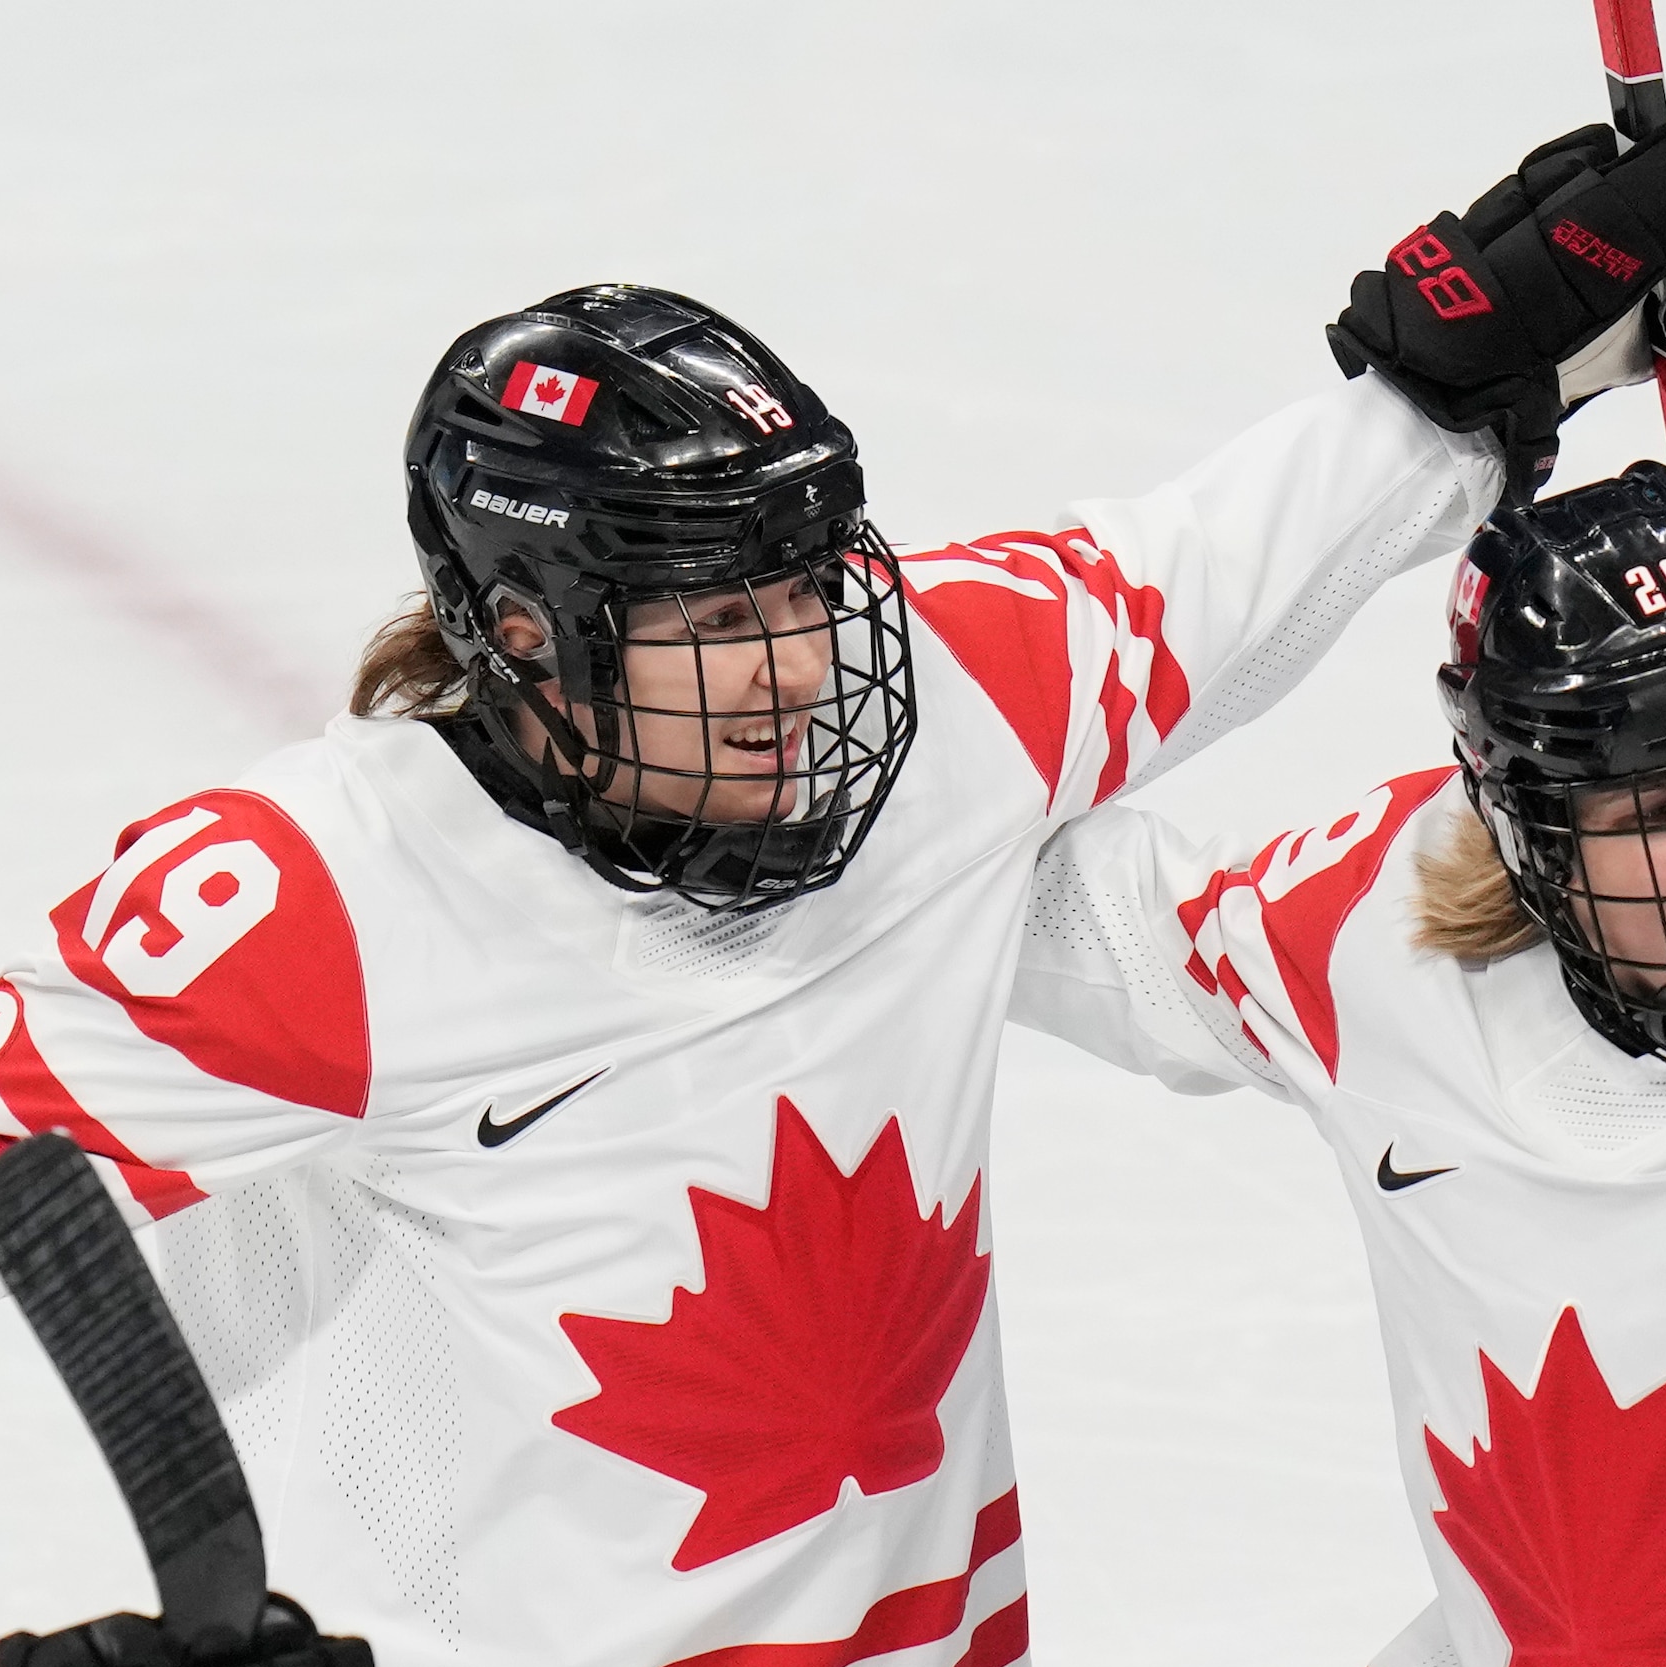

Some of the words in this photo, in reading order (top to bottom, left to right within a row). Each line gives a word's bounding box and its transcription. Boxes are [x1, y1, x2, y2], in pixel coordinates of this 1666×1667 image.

[1386, 224, 1493, 320] BA
[725, 383, 796, 435] 19
[81, 805, 282, 999] 19
